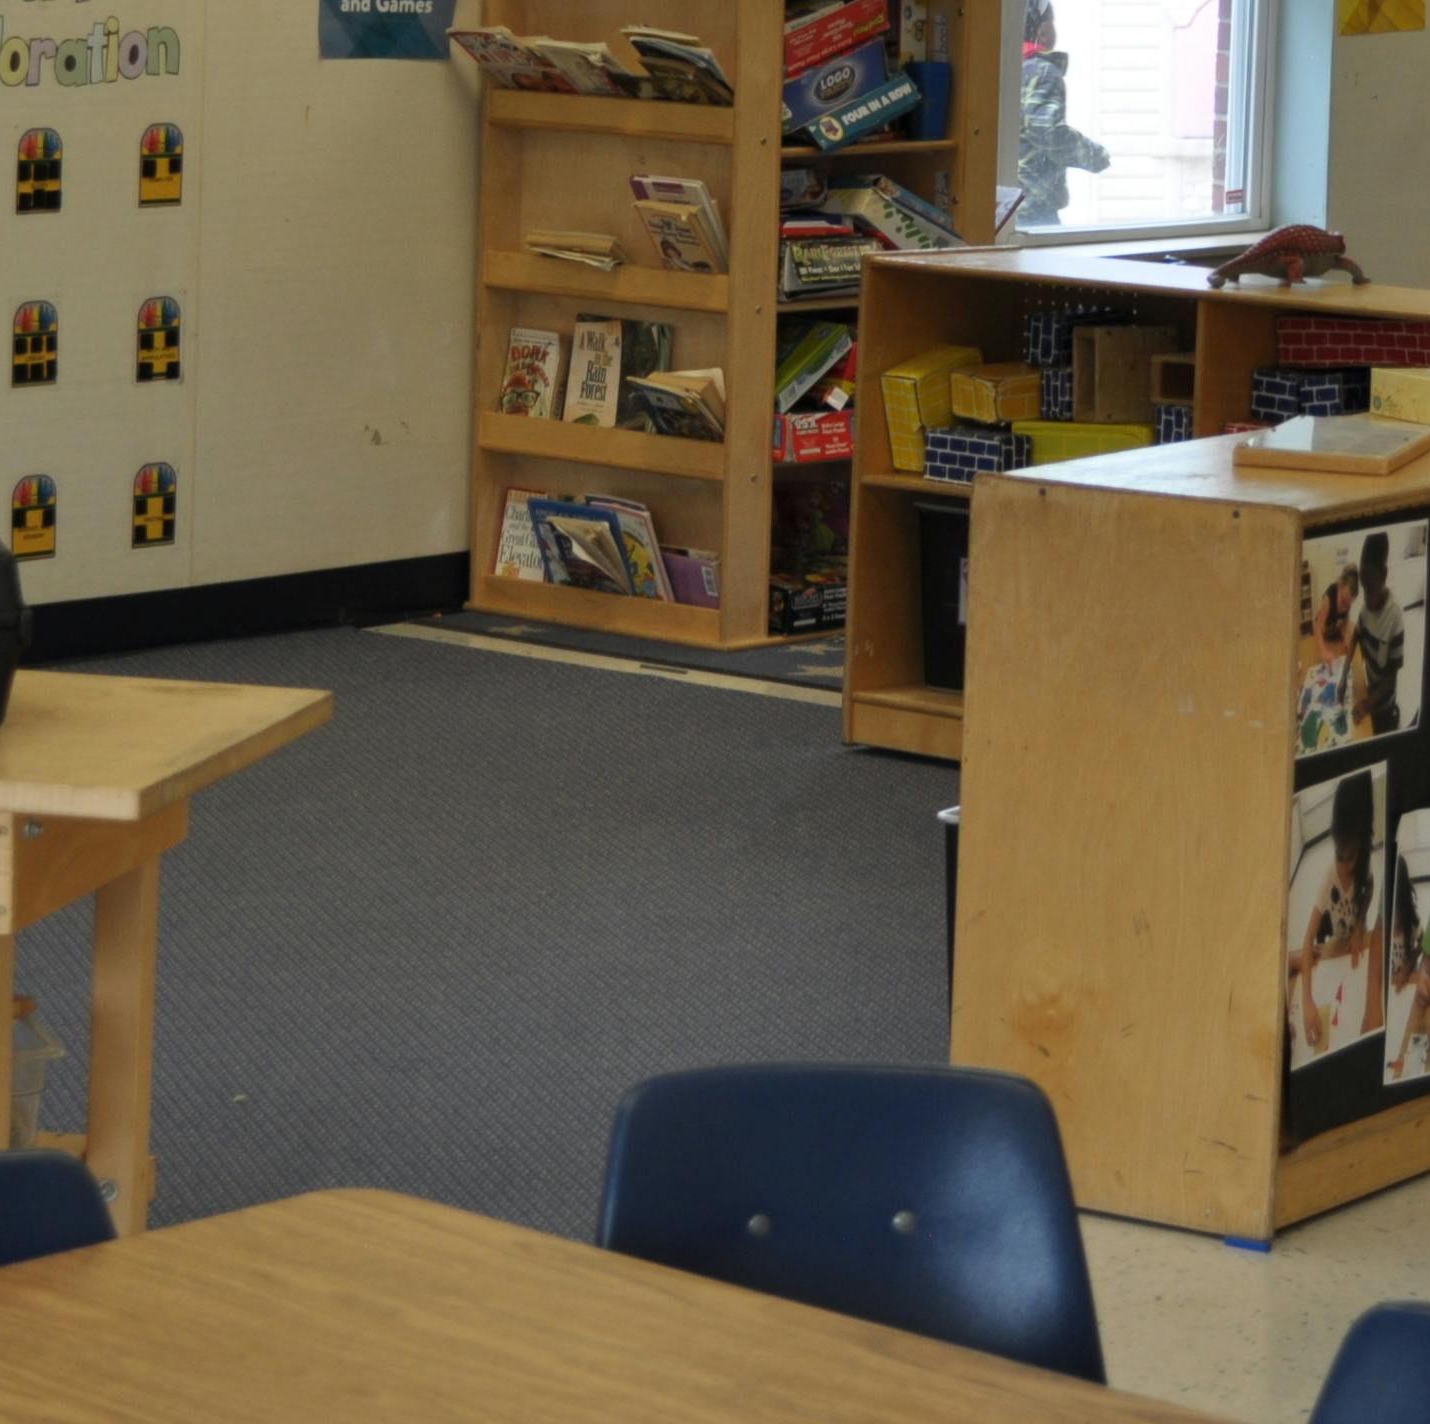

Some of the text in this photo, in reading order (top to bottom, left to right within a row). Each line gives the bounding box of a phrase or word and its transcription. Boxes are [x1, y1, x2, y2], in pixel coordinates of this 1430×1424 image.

[820, 67, 851, 90] LOGO
[841, 83, 914, 126] FOUR IN A ROW
[586, 330, 606, 352] Walk
[586, 360, 607, 383] Rain
[579, 383, 608, 402] Forest
